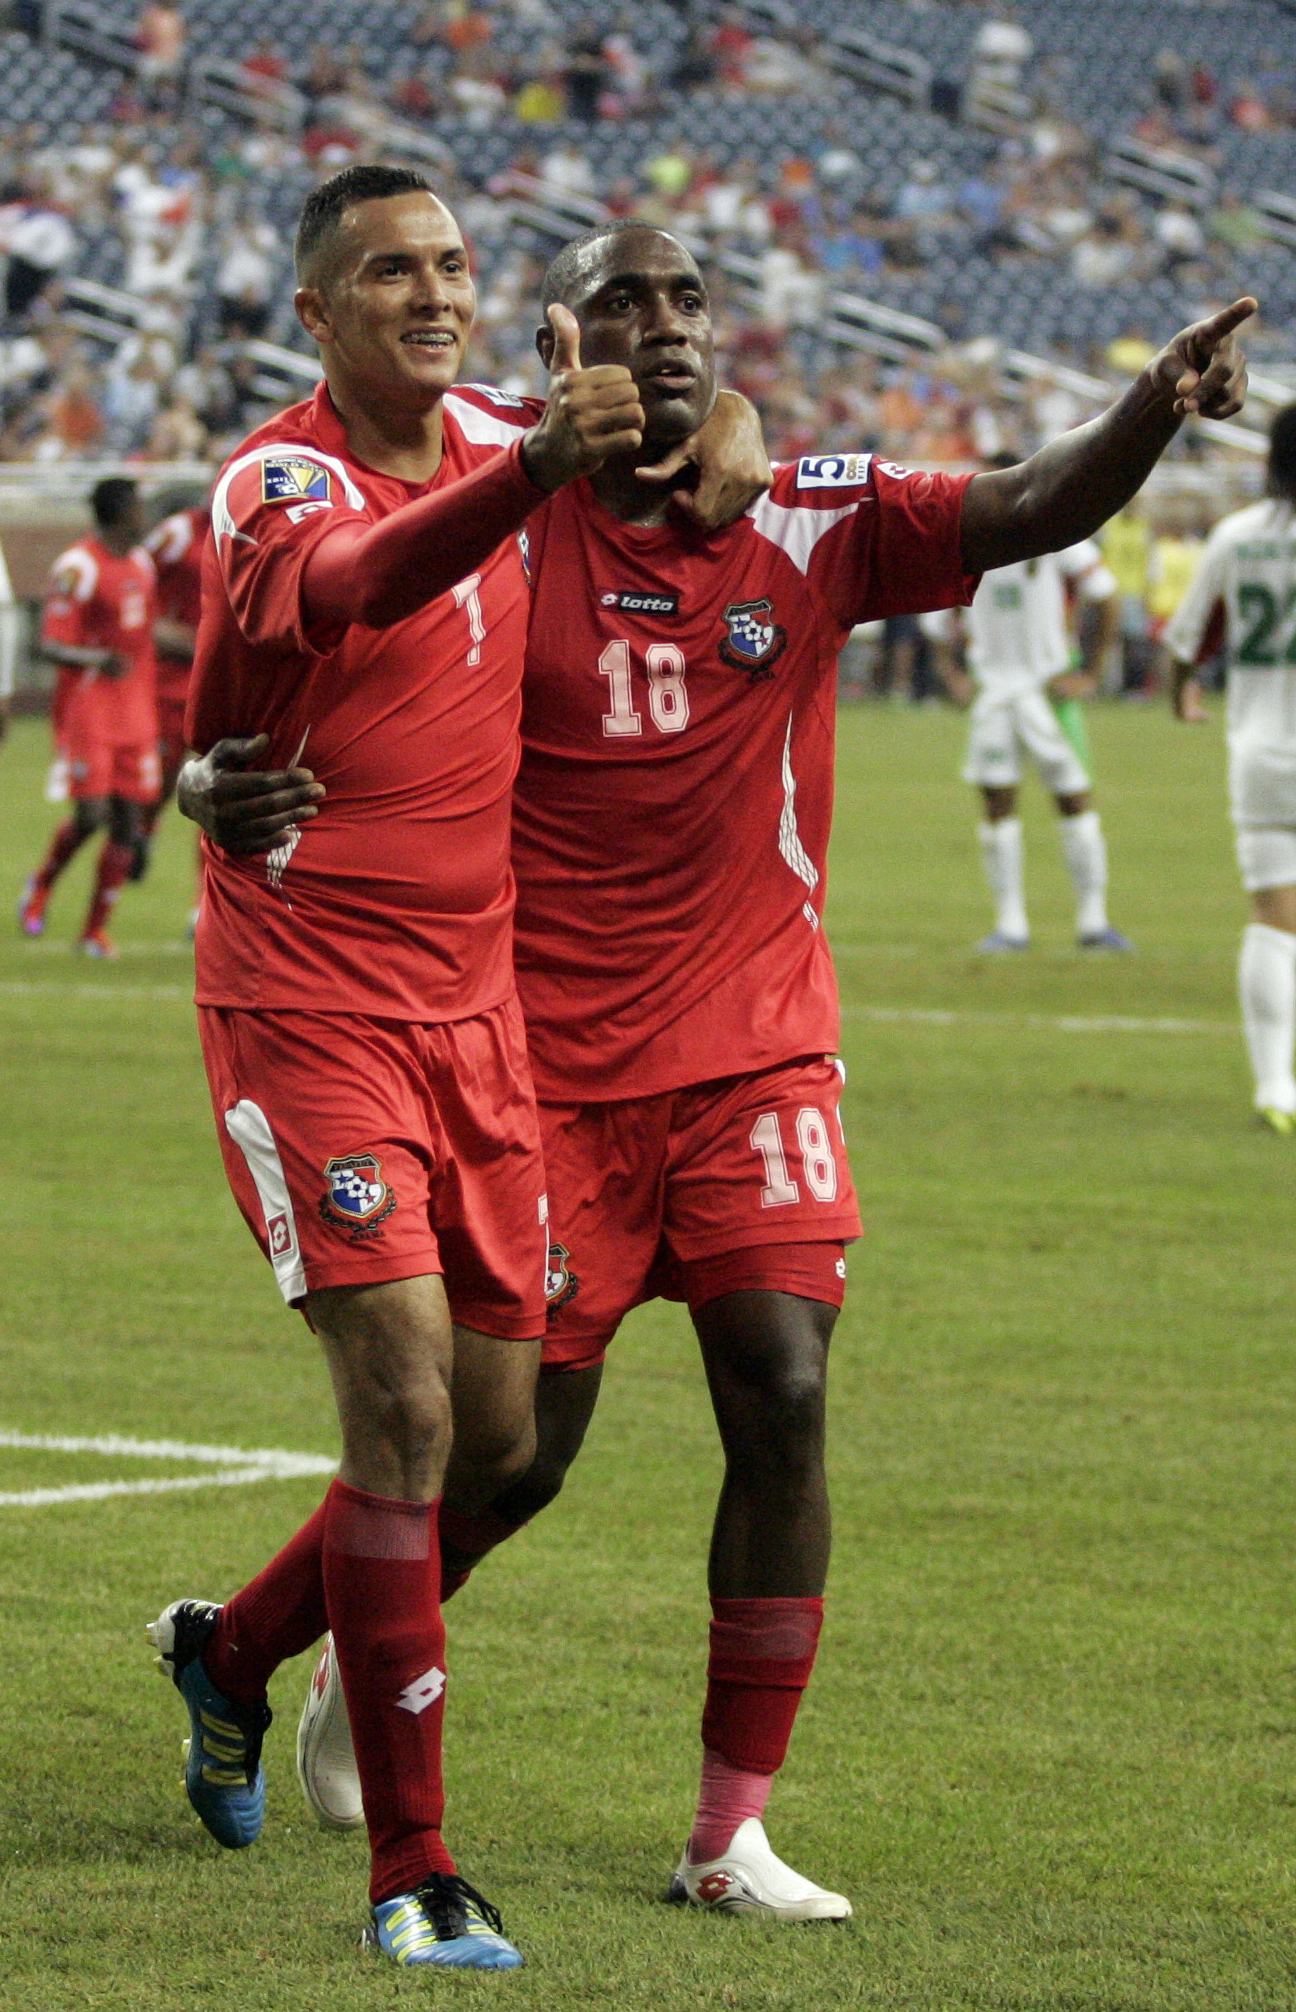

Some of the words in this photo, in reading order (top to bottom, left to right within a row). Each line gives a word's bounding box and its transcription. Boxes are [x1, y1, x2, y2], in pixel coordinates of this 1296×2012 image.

[620, 596, 674, 611] lotto
[598, 639, 690, 738] 18
[749, 1107, 838, 1208] 18
